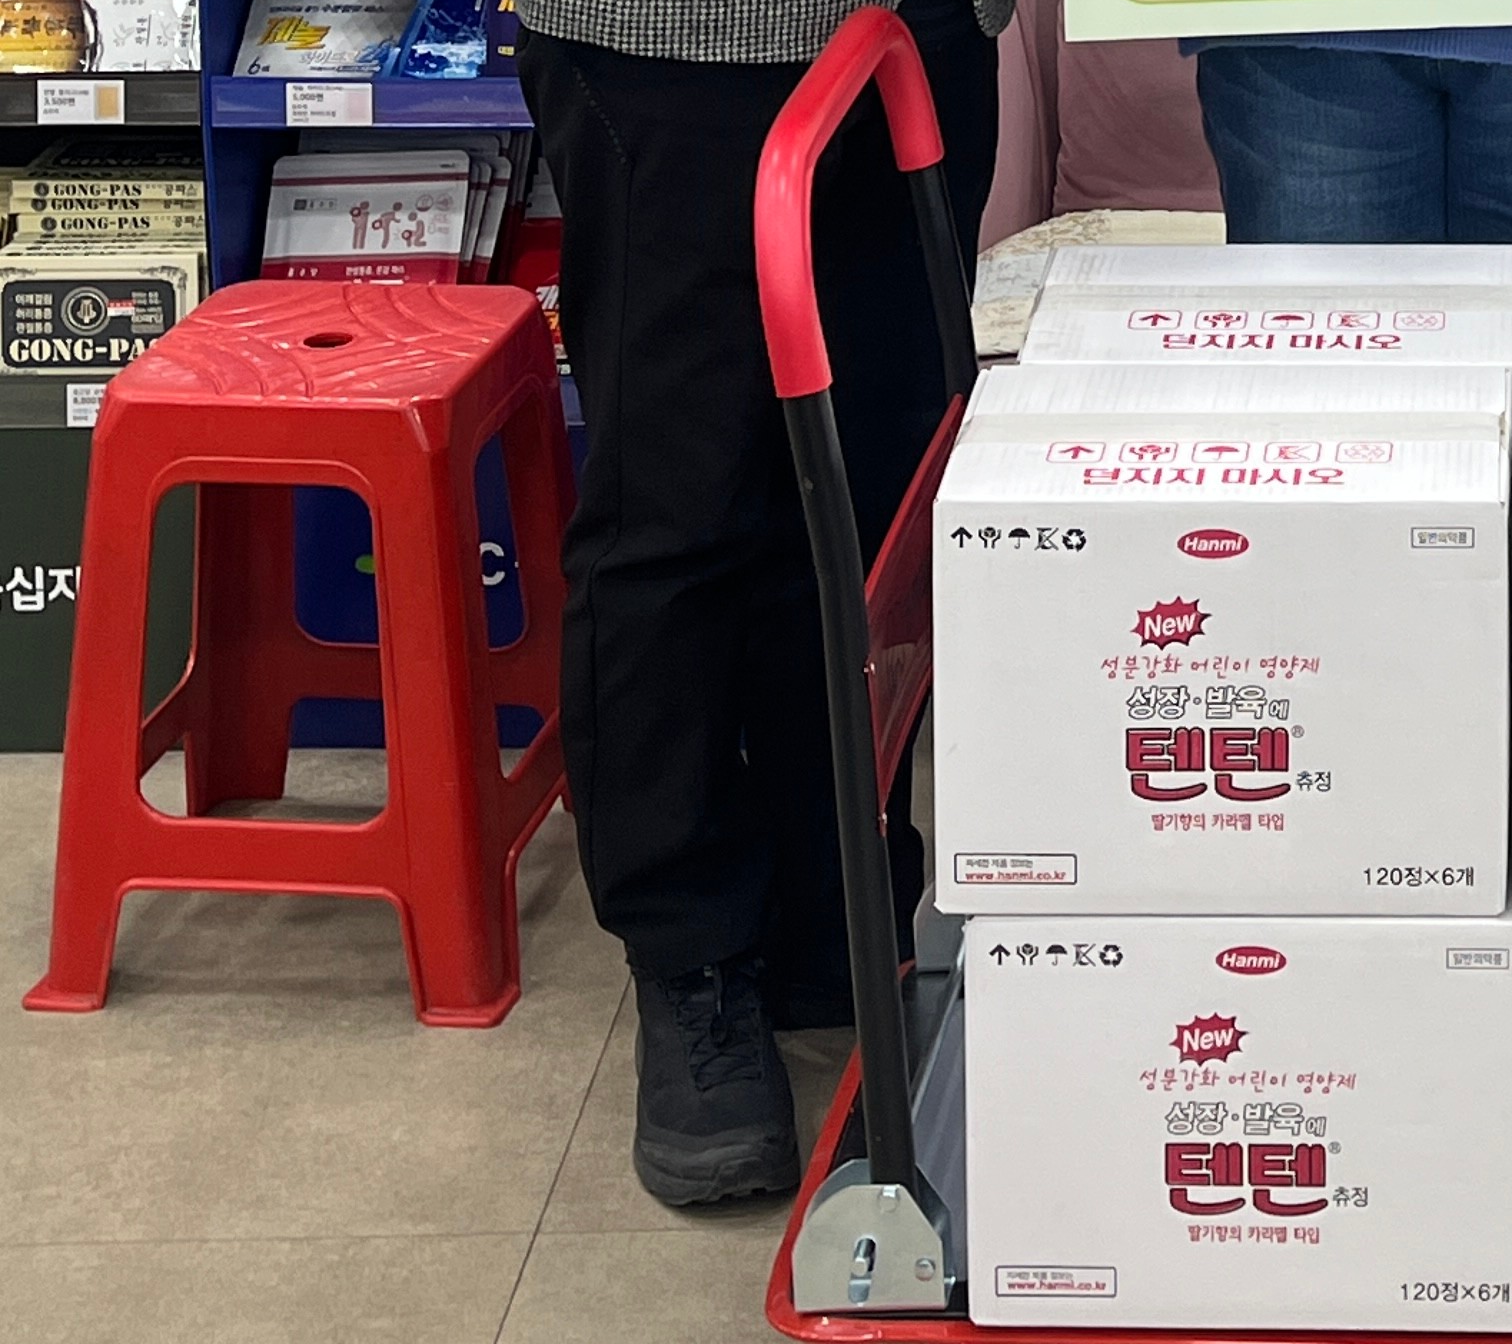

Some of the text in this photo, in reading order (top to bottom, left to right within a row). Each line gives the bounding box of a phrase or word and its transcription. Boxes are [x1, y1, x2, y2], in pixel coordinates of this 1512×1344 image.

[53, 183, 142, 197] GONG-PAS
[51, 199, 140, 211] GONG-PAS
[61, 216, 150, 230] GONG-PAS
[9, 337, 160, 363] GONG-PA
[1163, 333, 1402, 351] 던지지 마시오
[1083, 466, 1345, 486] 던지지 마시오
[1183, 534, 1244, 554] Hanmi
[1143, 612, 1197, 640] New
[1101, 656, 1320, 680] 성분강화 어린이 영양제
[1295, 770, 1333, 792] 츄정
[1151, 813, 1206, 832] 딸기향의
[1256, 813, 1286, 831] 타입
[965, 870, 1067, 883] www.hanmi.co.kr
[1221, 951, 1282, 970] Hanmi
[1182, 1026, 1234, 1054] New
[1139, 1068, 1357, 1093] 성분강화 어린이 영양제
[1332, 1186, 1370, 1208] 츄정
[1187, 1223, 1242, 1243] 딸기향의
[1293, 1224, 1321, 1244] 타입
